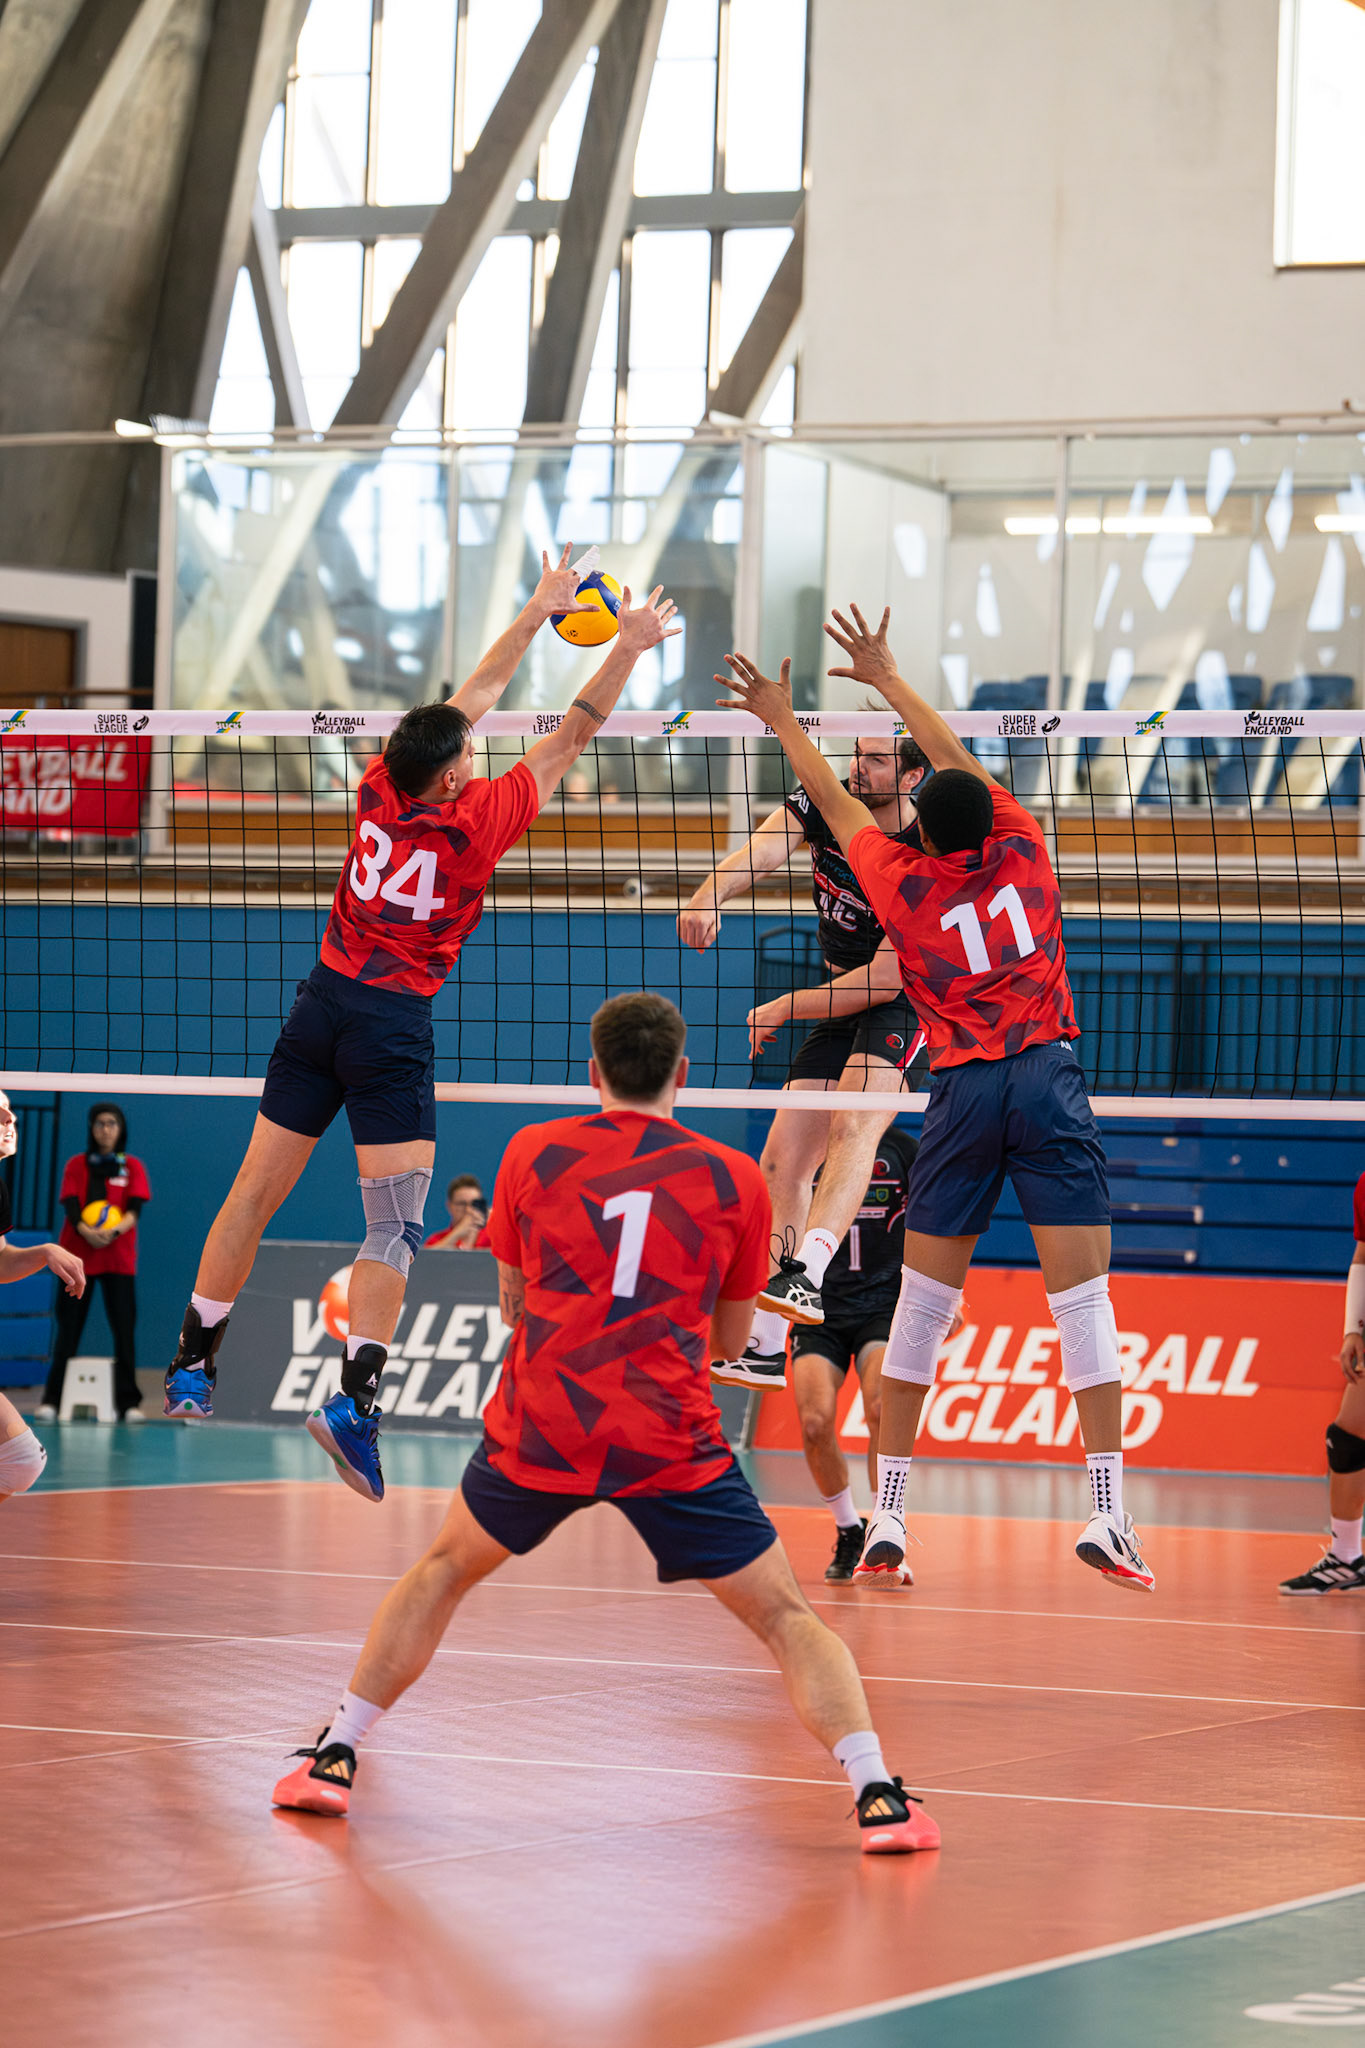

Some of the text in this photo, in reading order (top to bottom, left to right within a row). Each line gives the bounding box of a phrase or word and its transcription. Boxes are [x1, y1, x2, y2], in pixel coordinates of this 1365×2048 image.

[97, 714, 128, 724] SUPER
[1002, 714, 1036, 725] SUPER
[93, 724, 129, 734] LEAGUE
[313, 725, 355, 735] ENGLAND
[533, 724, 560, 735] LEAG
[998, 725, 1037, 735] LEAGUE
[1244, 726, 1292, 735] ENGLAND
[350, 820, 445, 920] 34
[940, 883, 1036, 975] 11
[602, 1190, 653, 1298] 1
